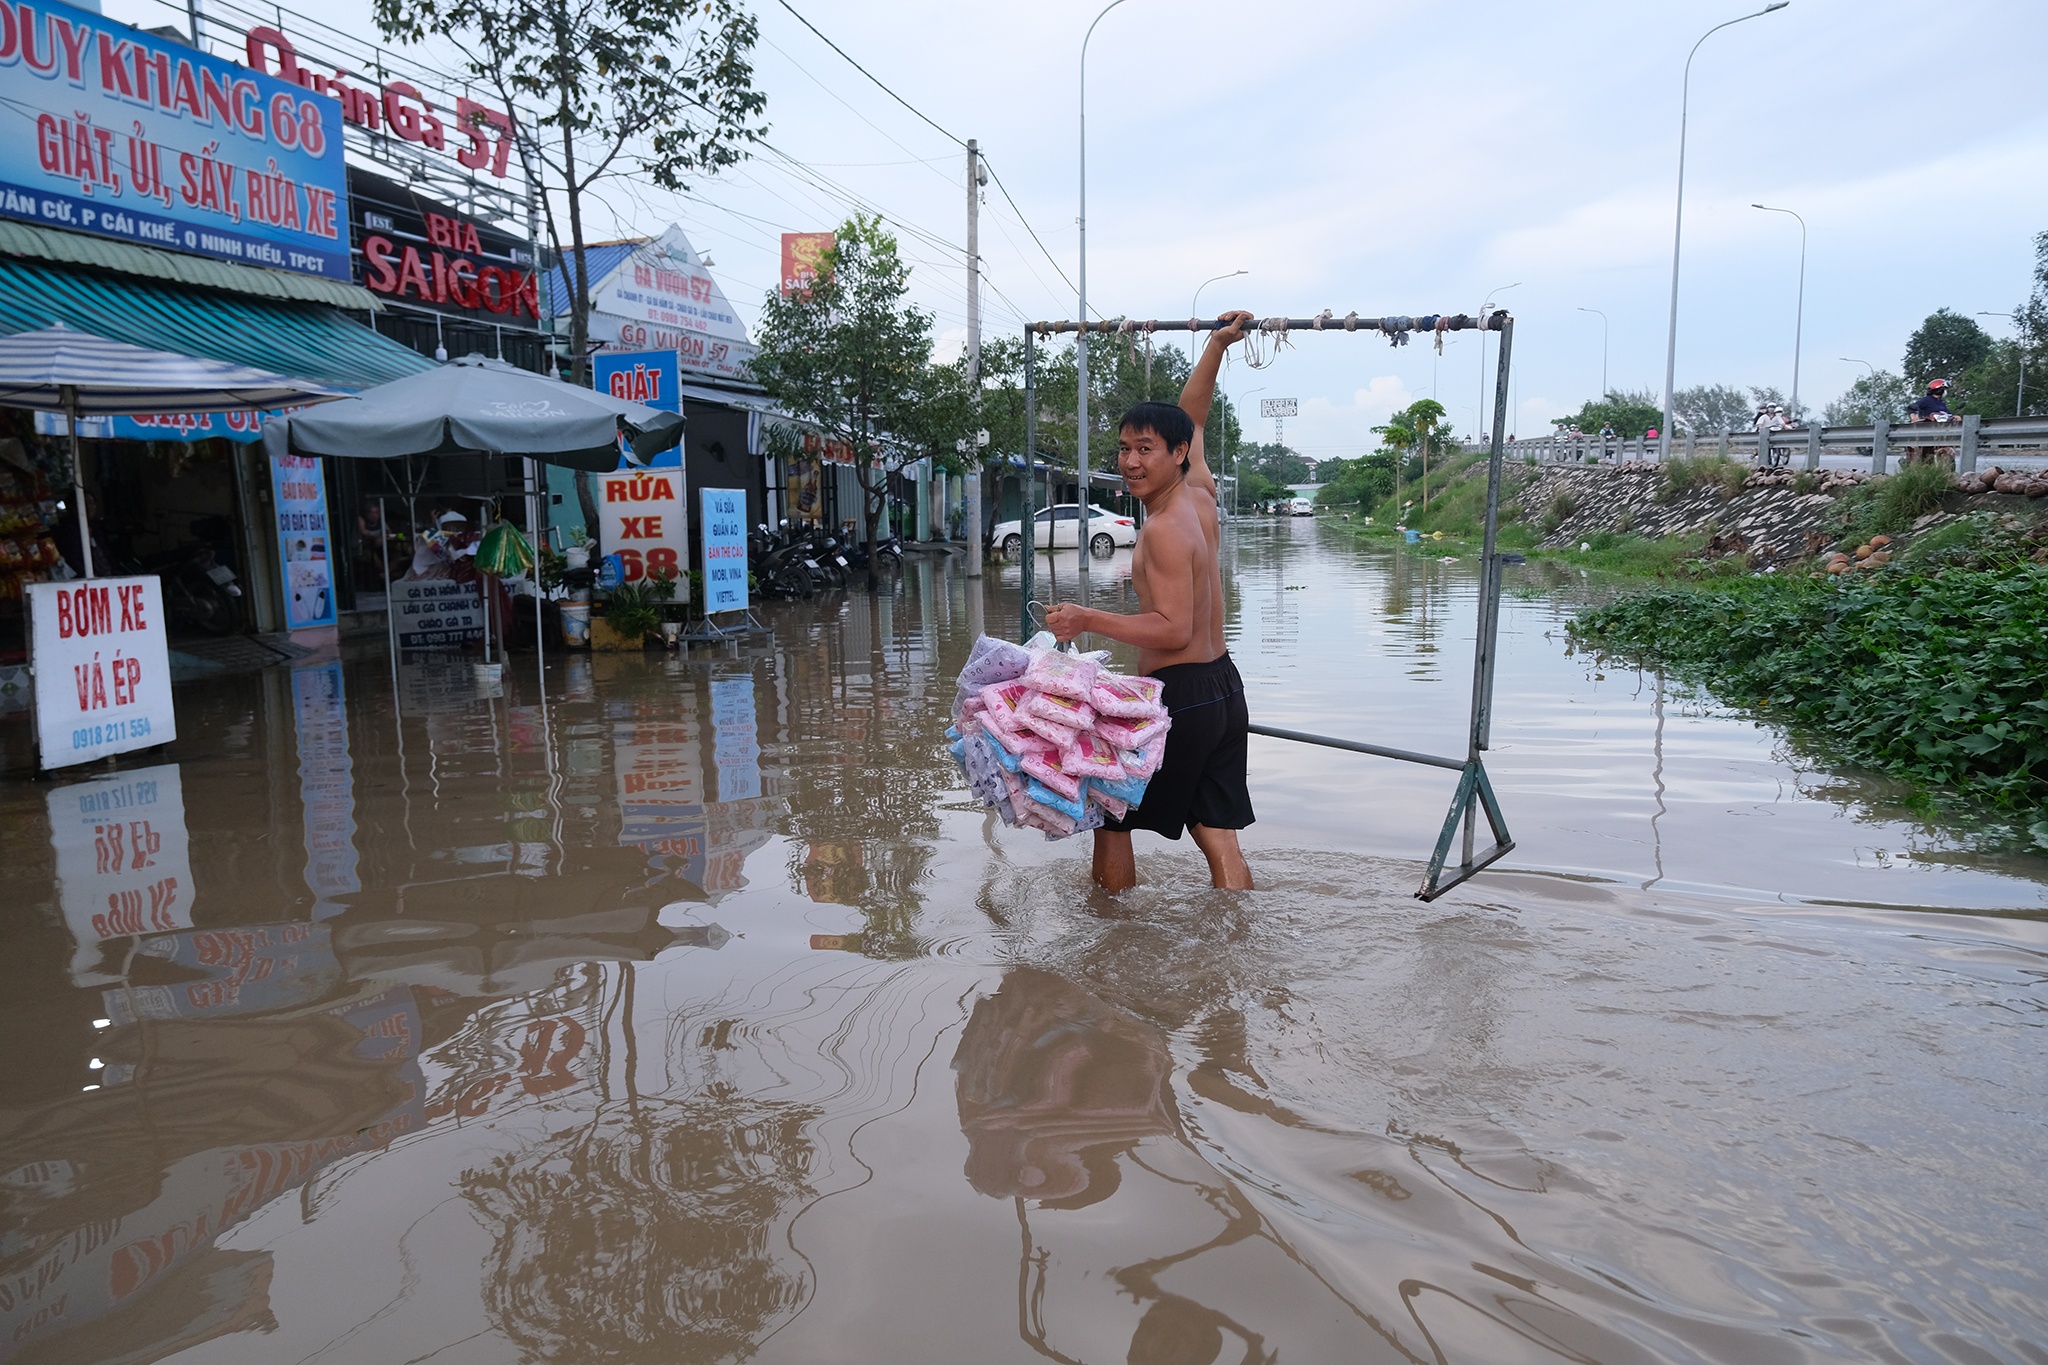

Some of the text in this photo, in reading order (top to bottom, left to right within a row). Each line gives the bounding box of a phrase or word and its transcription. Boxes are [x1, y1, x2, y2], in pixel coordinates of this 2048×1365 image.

[97, 33, 265, 137] KHANG
[271, 94, 325, 154] 68
[383, 81, 446, 151] Gà
[456, 96, 517, 179] 57
[37, 110, 339, 239] GIẶT, ỦI, SẤY, RỬA XE
[42, 199, 78, 226] CỪ,
[82, 208, 97, 226] P
[101, 213, 134, 236] CÁI
[139, 221, 181, 246] KHẾ,
[185, 230, 198, 249] Q
[201, 233, 243, 256] NINH
[289, 253, 325, 273] TPCT
[371, 215, 392, 231] EST.
[424, 213, 483, 255] BIA
[363, 236, 540, 319] SAIGON
[691, 275, 712, 304] 57
[681, 357, 700, 366] HANH
[713, 343, 729, 360] 57
[606, 471, 674, 502] RỬA
[715, 499, 723, 513] VÁ
[620, 516, 663, 540] XE
[612, 547, 679, 583] 68
[708, 544, 720, 558] BÁN
[729, 568, 741, 580] VINA
[56, 583, 147, 638] BƠM XE
[438, 601, 469, 612] CHANH
[74, 649, 142, 712] VÁ ÉP
[73, 717, 152, 749] 0918 211 554
